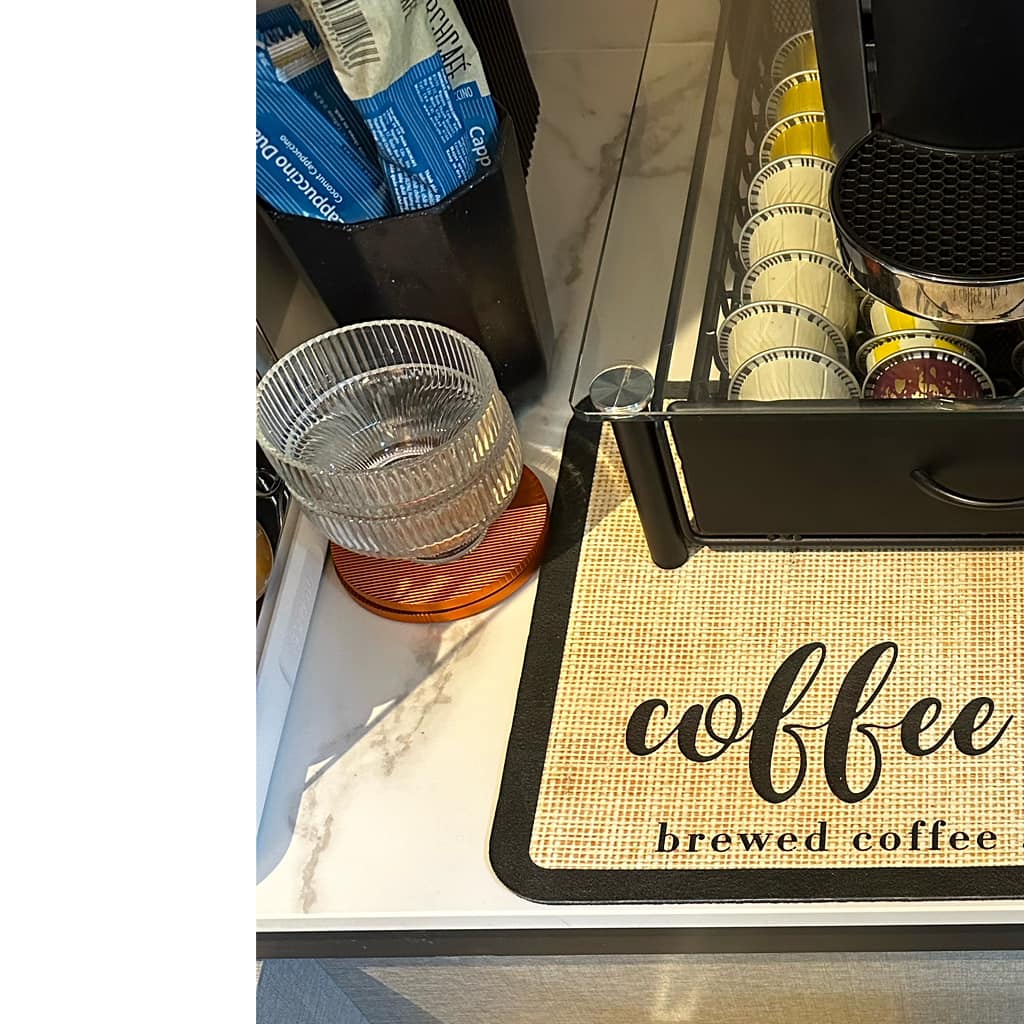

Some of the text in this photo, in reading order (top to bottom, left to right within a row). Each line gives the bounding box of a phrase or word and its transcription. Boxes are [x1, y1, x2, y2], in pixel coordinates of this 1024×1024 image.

[280, 134, 314, 175] Cappuccino
[468, 125, 491, 167] Capp
[312, 165, 343, 203] Coconut
[626, 641, 1014, 804] coffee
[656, 821, 828, 854] brewed
[852, 820, 999, 852] coffee
